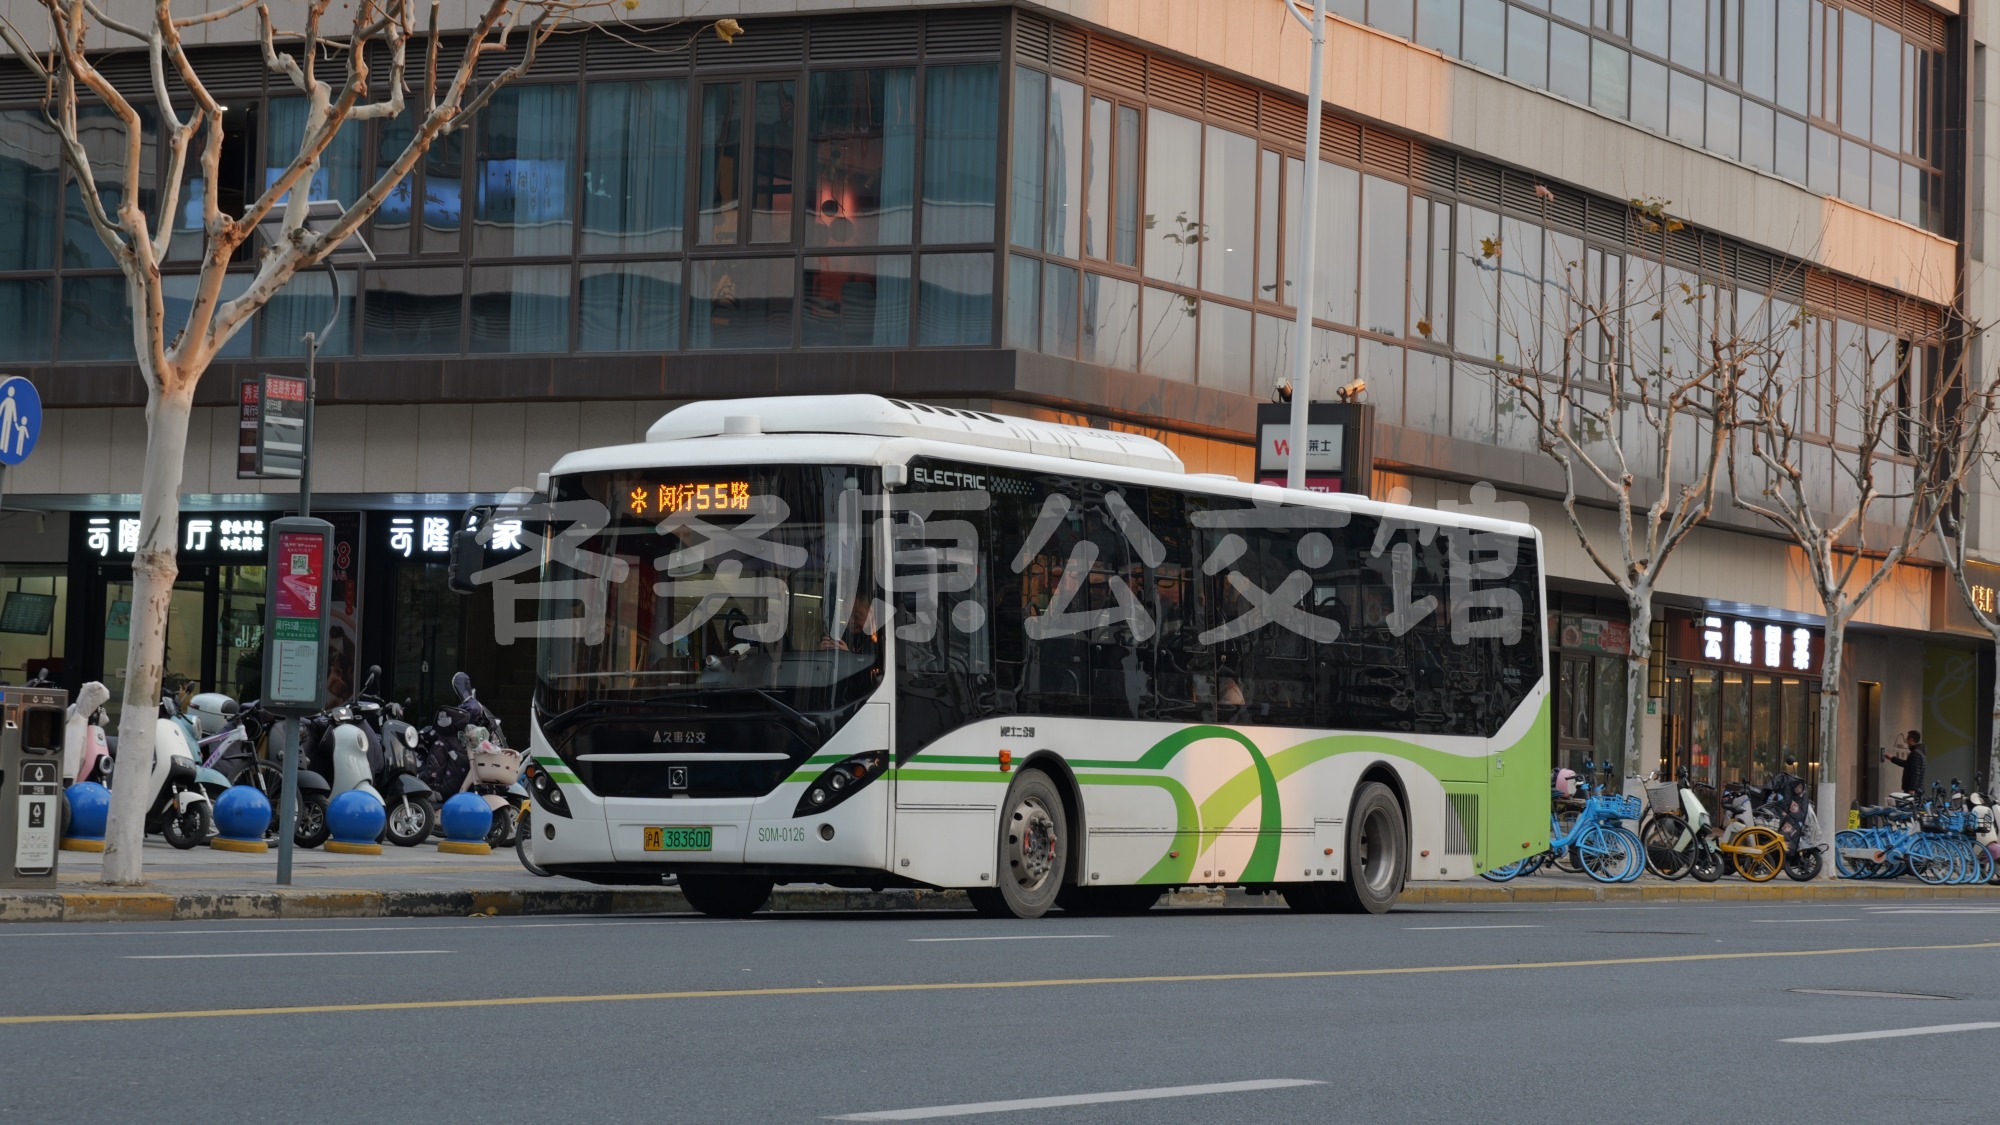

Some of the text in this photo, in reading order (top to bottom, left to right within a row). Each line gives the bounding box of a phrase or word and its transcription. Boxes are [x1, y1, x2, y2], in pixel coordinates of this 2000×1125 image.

[1308, 439, 1331, 452] 莱士
[914, 467, 986, 490] ELECTRIC
[659, 481, 750, 512] 闵行55路
[88, 518, 213, 556] 云隆厅
[390, 517, 523, 557] 云隆家
[275, 619, 300, 631] 闵行55路
